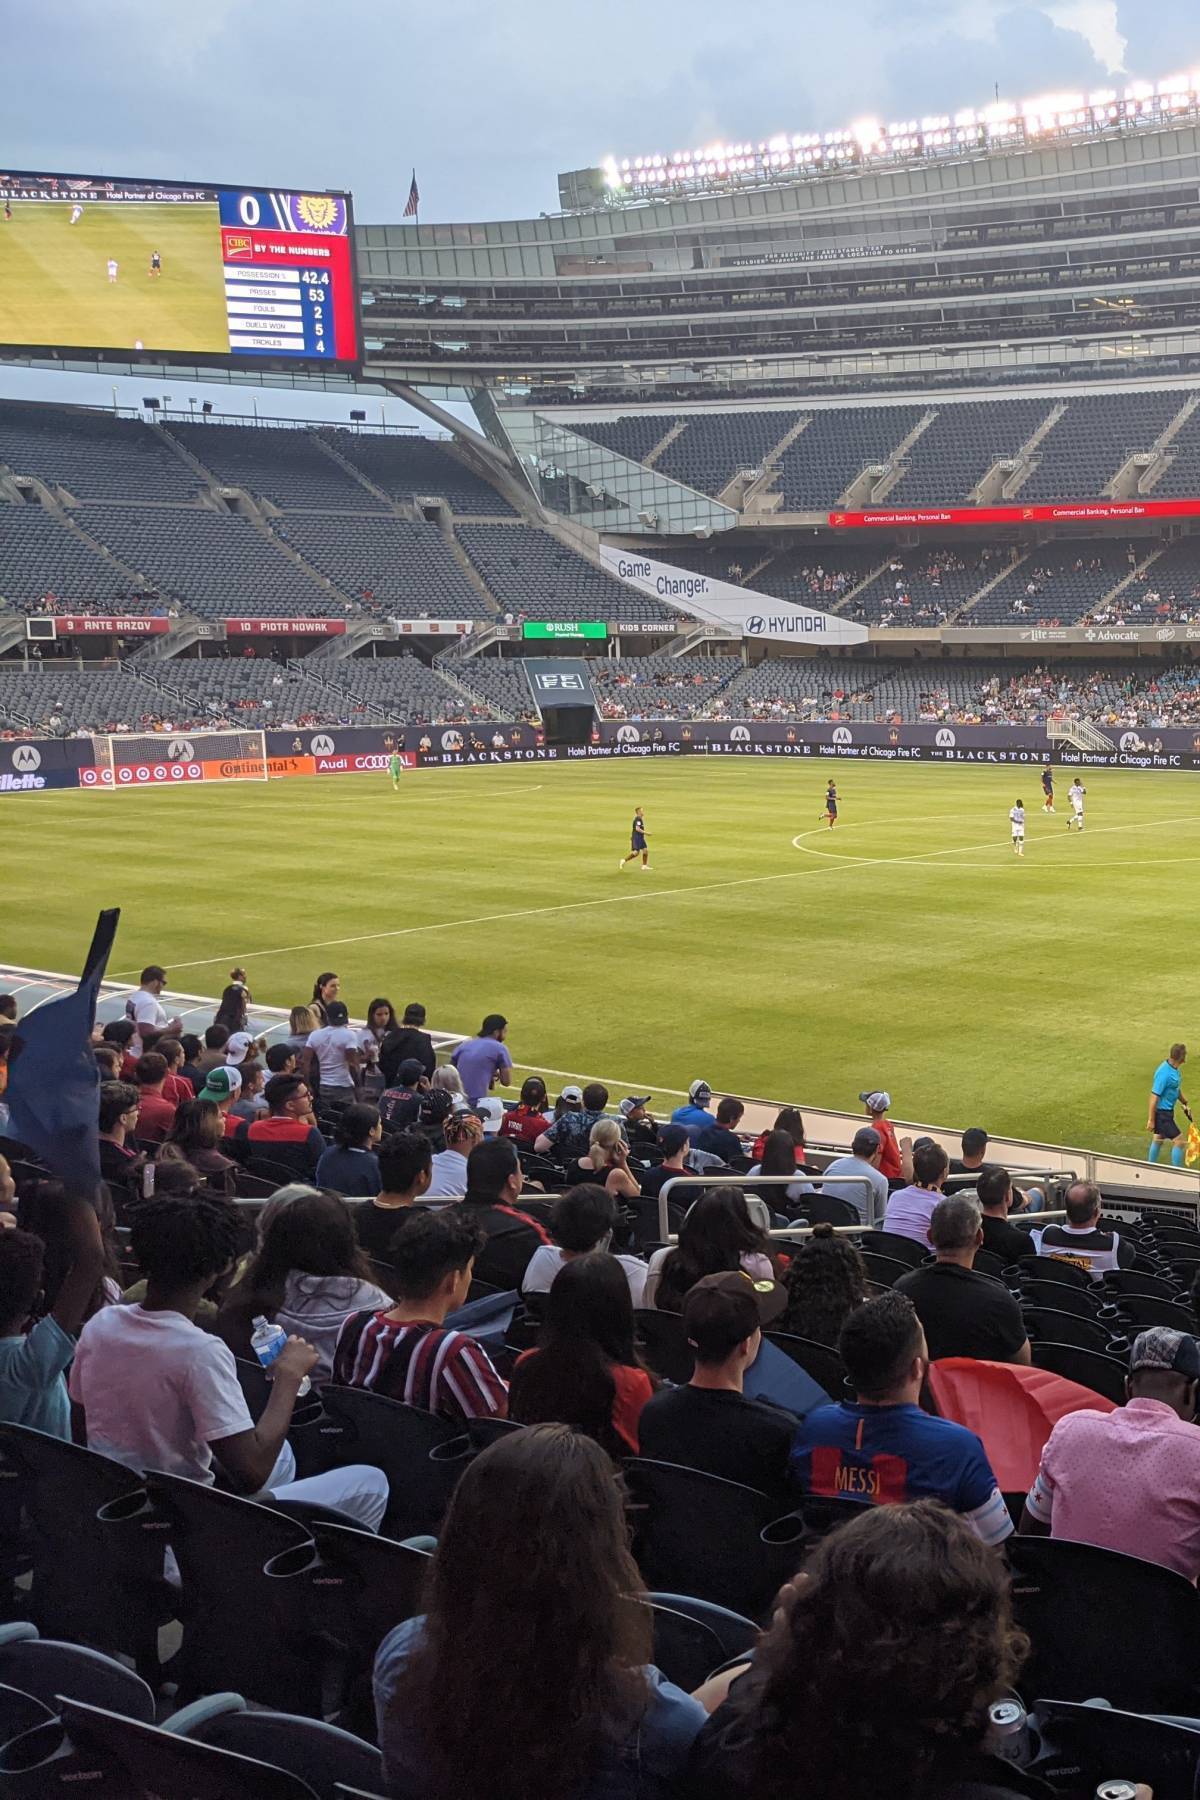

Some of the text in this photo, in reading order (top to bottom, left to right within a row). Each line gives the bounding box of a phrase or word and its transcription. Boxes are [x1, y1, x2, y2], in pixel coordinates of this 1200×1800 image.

[124, 192, 145, 200] Partner
[155, 192, 181, 201] Chicago
[240, 195, 260, 226] 0
[254, 244, 330, 257] BY THE NUMBERS
[302, 271, 329, 285] 42.4
[309, 289, 325, 302] 53
[314, 306, 322, 319] 2
[315, 323, 324, 336] 5
[316, 340, 325, 353] 4
[618, 560, 651, 578] Game
[656, 577, 709, 597] Changer.
[85, 622, 112, 630] ANTE
[117, 621, 151, 630] RAZOV
[261, 623, 289, 631] PIOTR
[292, 623, 327, 631] NOWAK
[554, 624, 578, 632] RUSH
[620, 623, 675, 632] KIDS CORNER
[768, 616, 827, 632] HYUNDAI
[1098, 630, 1139, 641] Advocate
[567, 747, 586, 756] Hotel
[588, 747, 611, 756] Partner
[622, 744, 651, 755] Chicago
[653, 743, 667, 752] Fire
[668, 743, 680, 752] FC
[712, 743, 811, 754] BLACKSTONE
[819, 745, 836, 754] Hotel
[837, 746, 859, 755] Partner
[869, 746, 897, 758] Chicago
[898, 748, 910, 757] Fire
[911, 748, 921, 757] FC
[442, 749, 557, 763] BLACKSTONE
[946, 750, 1050, 762] BLACKSTONE
[1061, 752, 1181, 767] Hotel Partner of Chicago Fire FC
[220, 760, 288, 777] Continental
[319, 758, 347, 770] Audi
[0, 774, 46, 790] illette
[834, 1466, 881, 1495] MESSI
